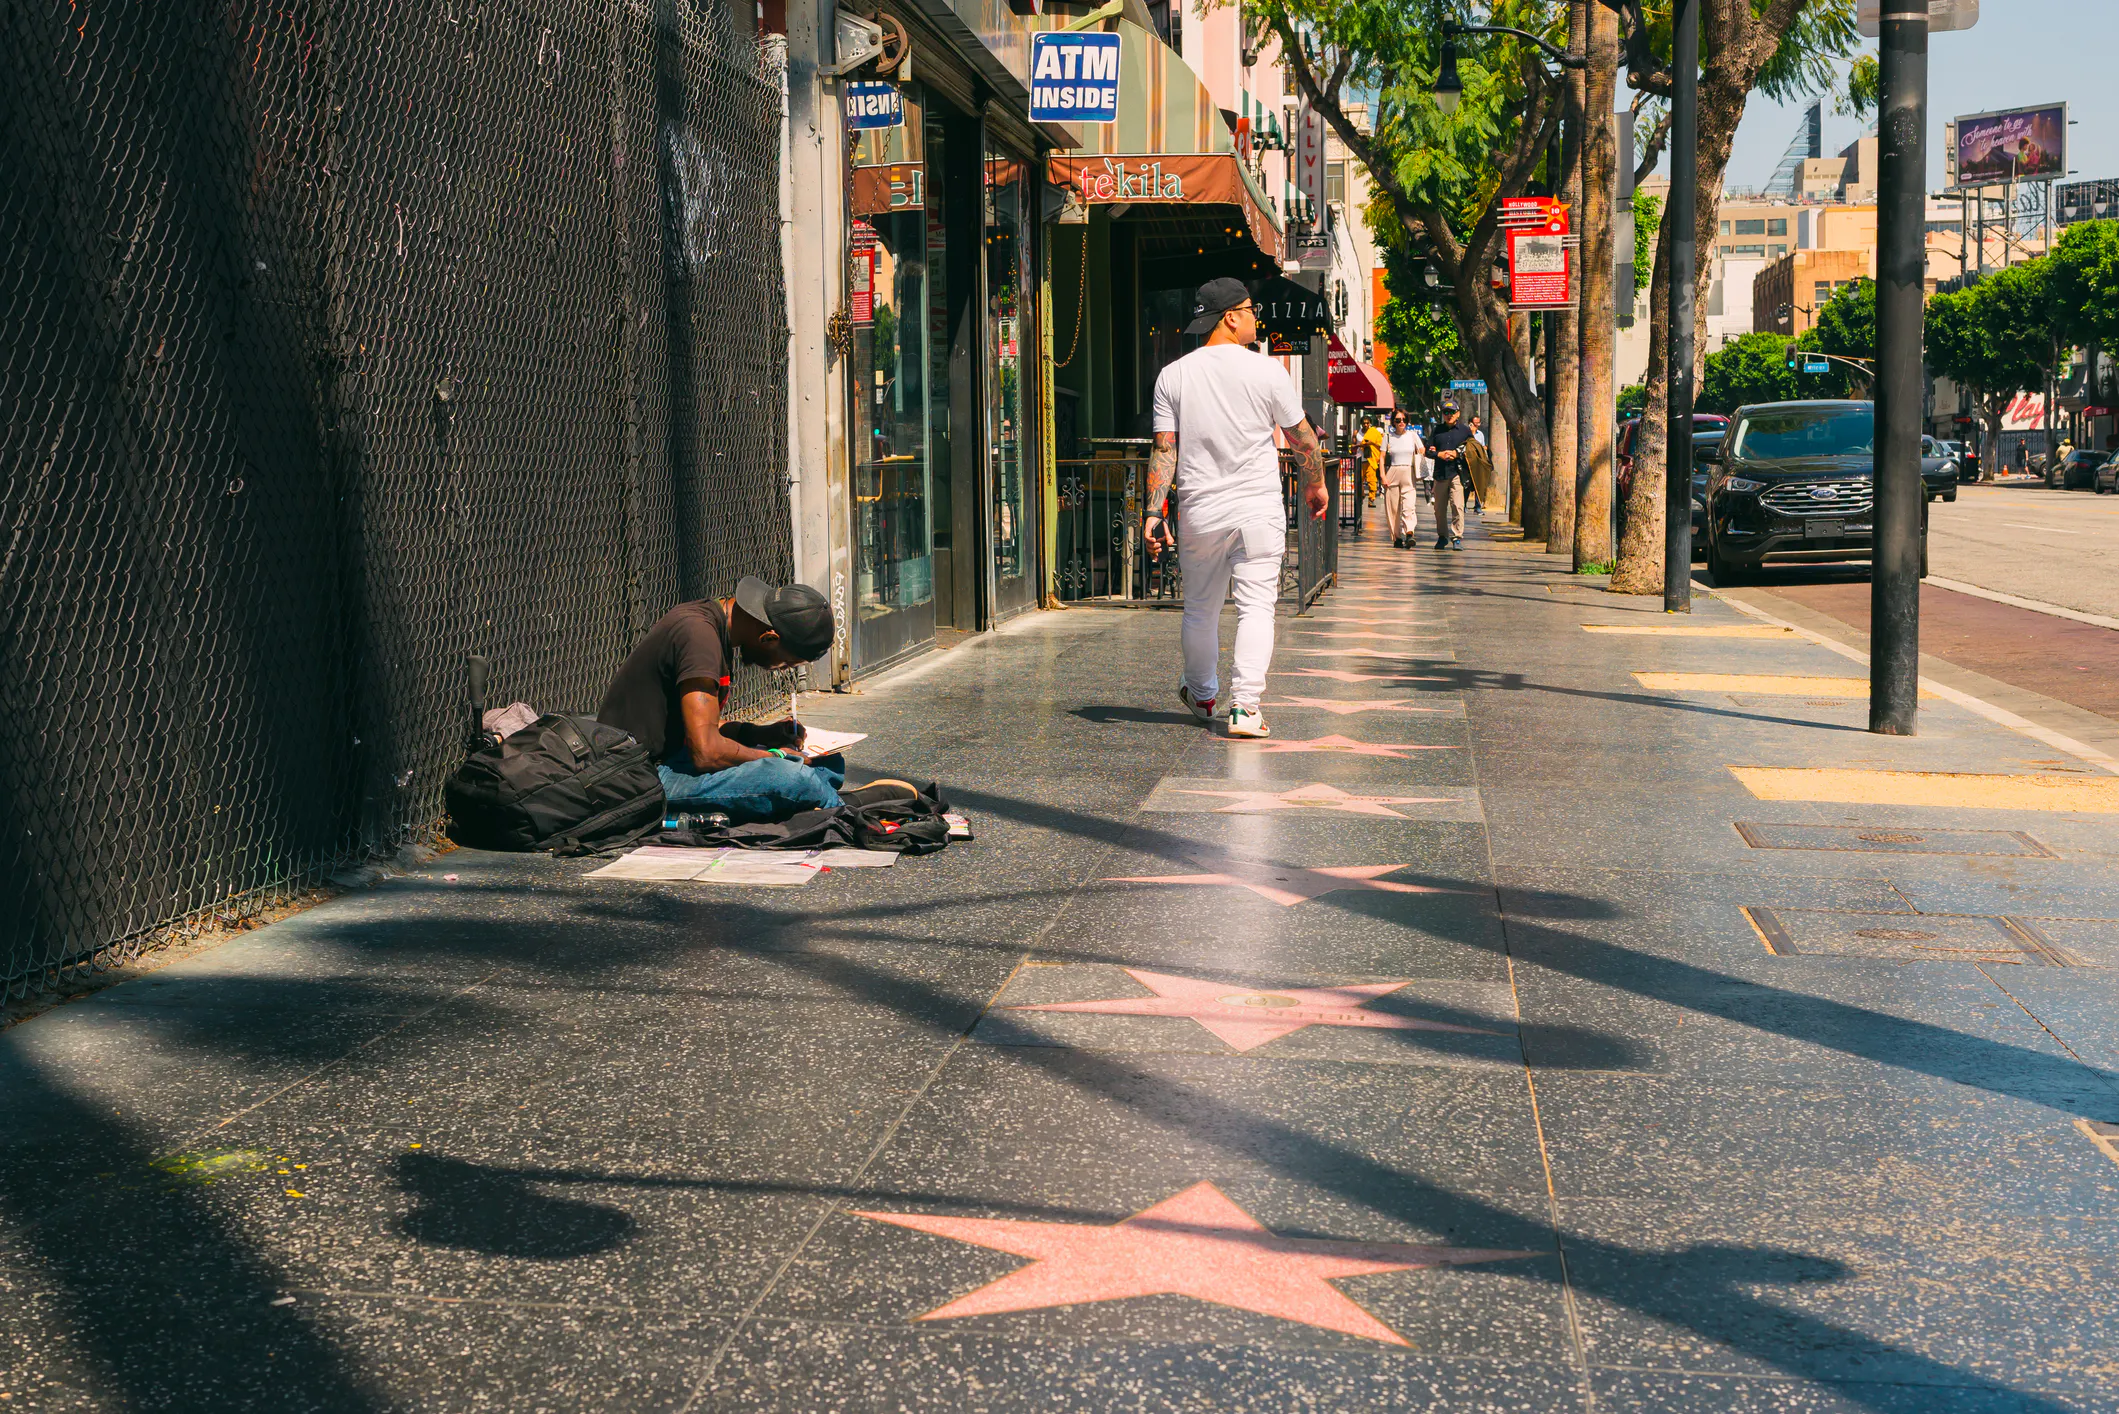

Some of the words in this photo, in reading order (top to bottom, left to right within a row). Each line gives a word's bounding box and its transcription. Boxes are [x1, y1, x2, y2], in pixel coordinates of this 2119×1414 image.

[1034, 46, 1117, 80] ATM
[1033, 87, 1115, 109] INSIDE
[1961, 124, 2003, 147] Someone
[2004, 117, 2010, 130] to
[2010, 118, 2024, 133] go
[1980, 139, 1988, 151] to
[1990, 133, 2015, 148] heaven
[2017, 124, 2033, 140] with
[1299, 238, 1324, 247] APTS
[1256, 302, 1323, 318] PIZZA
[1328, 365, 1357, 374] SOUVENIR
